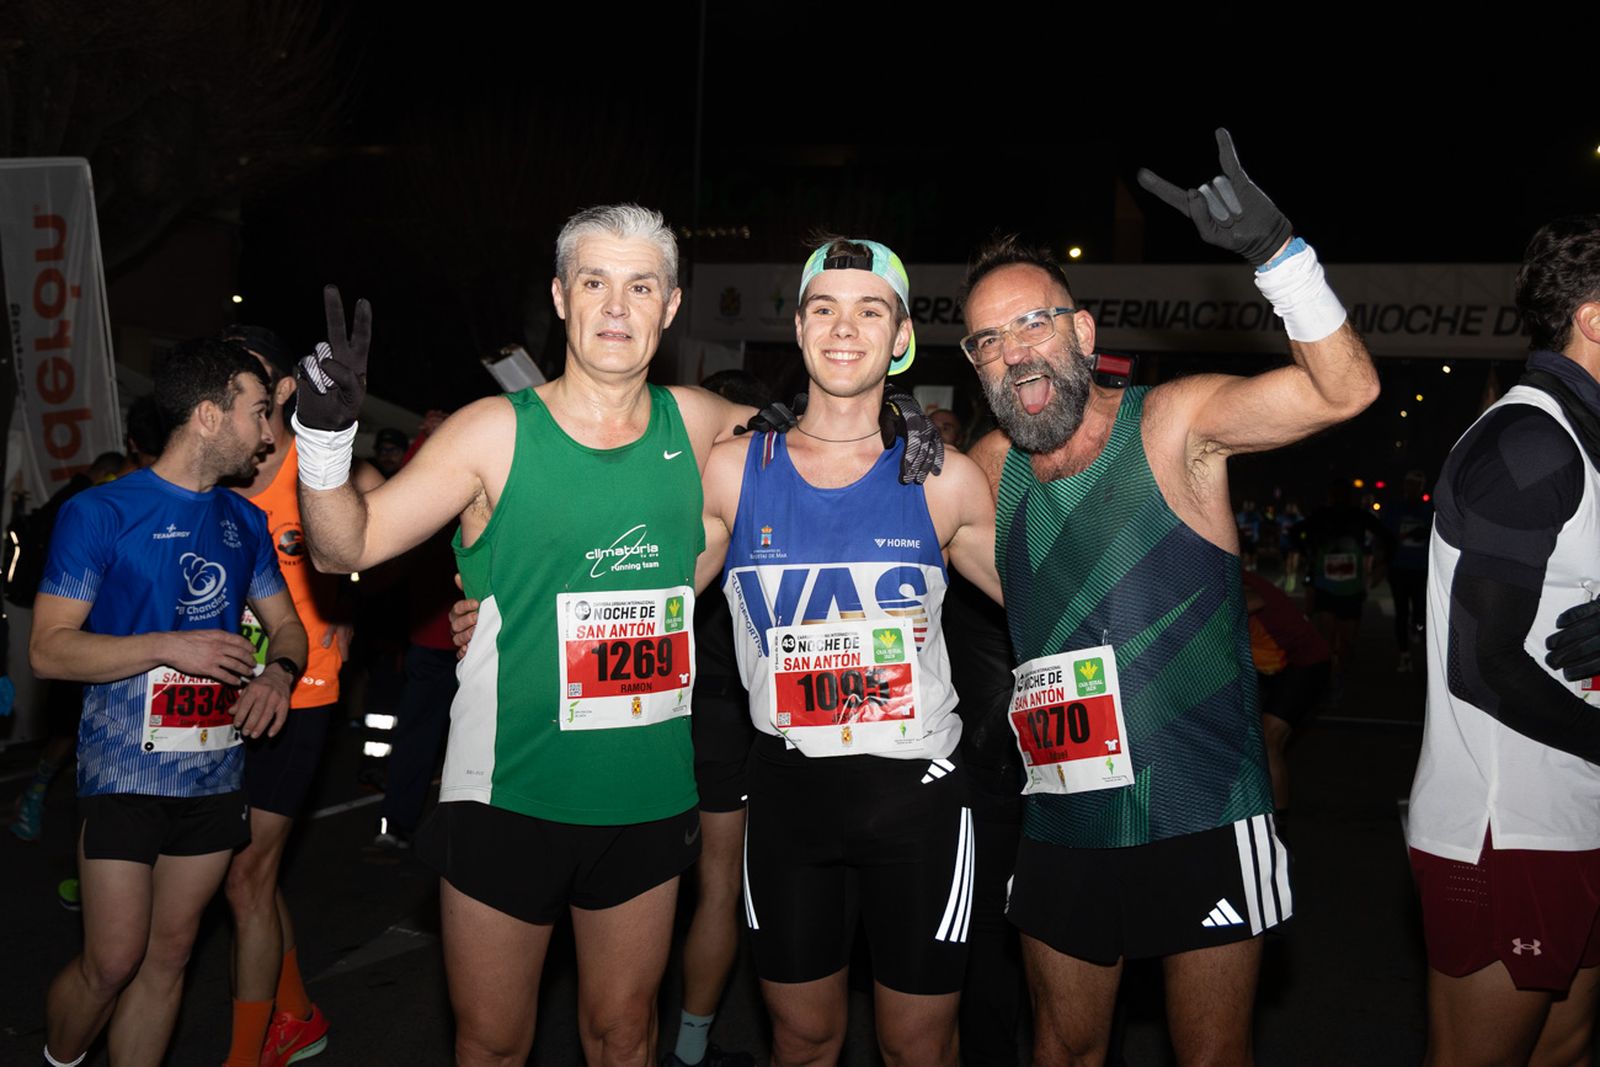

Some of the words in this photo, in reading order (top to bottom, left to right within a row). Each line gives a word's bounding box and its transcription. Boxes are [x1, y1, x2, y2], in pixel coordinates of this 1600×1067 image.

[1353, 304, 1487, 336] NOCHE
[887, 538, 921, 549] HORME
[611, 563, 642, 572] running
[642, 561, 659, 569] team
[594, 607, 637, 621] NOCHE
[640, 606, 655, 619] DE
[576, 624, 606, 639] SAN
[609, 619, 655, 638] ANTÓN
[798, 639, 840, 653] NOCHE
[843, 637, 860, 650] DE
[591, 638, 672, 682] 1269
[783, 656, 810, 671] SAN
[814, 651, 861, 669] ANTÓN
[163, 672, 186, 683] SAN
[1048, 671, 1063, 685] DE
[620, 683, 653, 693] RAMON
[1015, 696, 1029, 711] SAN
[1030, 685, 1065, 706] ANTÓN
[1027, 702, 1090, 750] 1270
